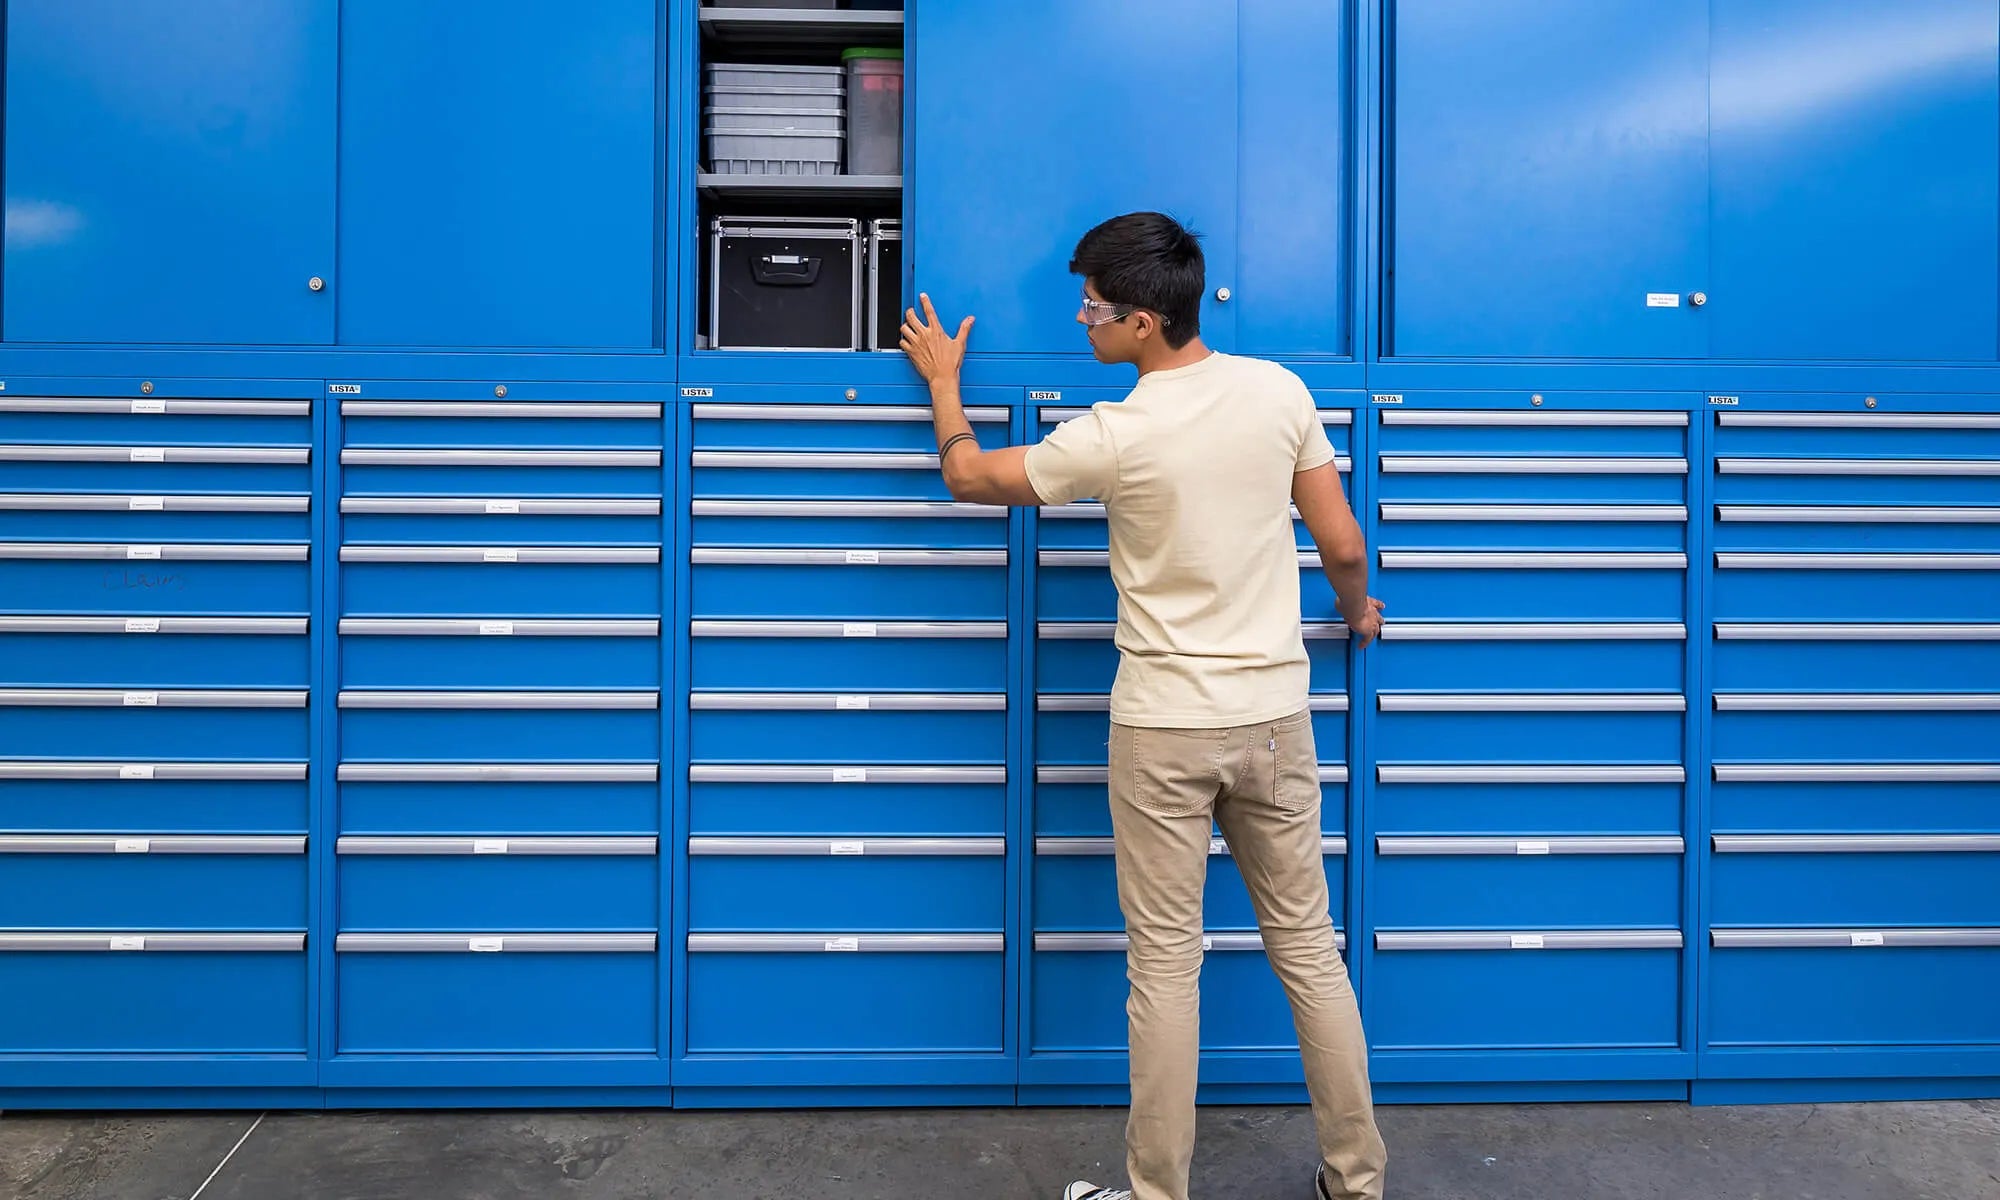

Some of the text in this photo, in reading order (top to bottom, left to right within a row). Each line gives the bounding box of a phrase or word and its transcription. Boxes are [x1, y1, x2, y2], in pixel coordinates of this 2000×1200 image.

[329, 385, 356, 393] LISTA
[682, 388, 708, 396] LISTA
[1030, 392, 1056, 400] LISTA
[1372, 395, 1398, 403] LISTA
[1708, 396, 1734, 404] LISTA
